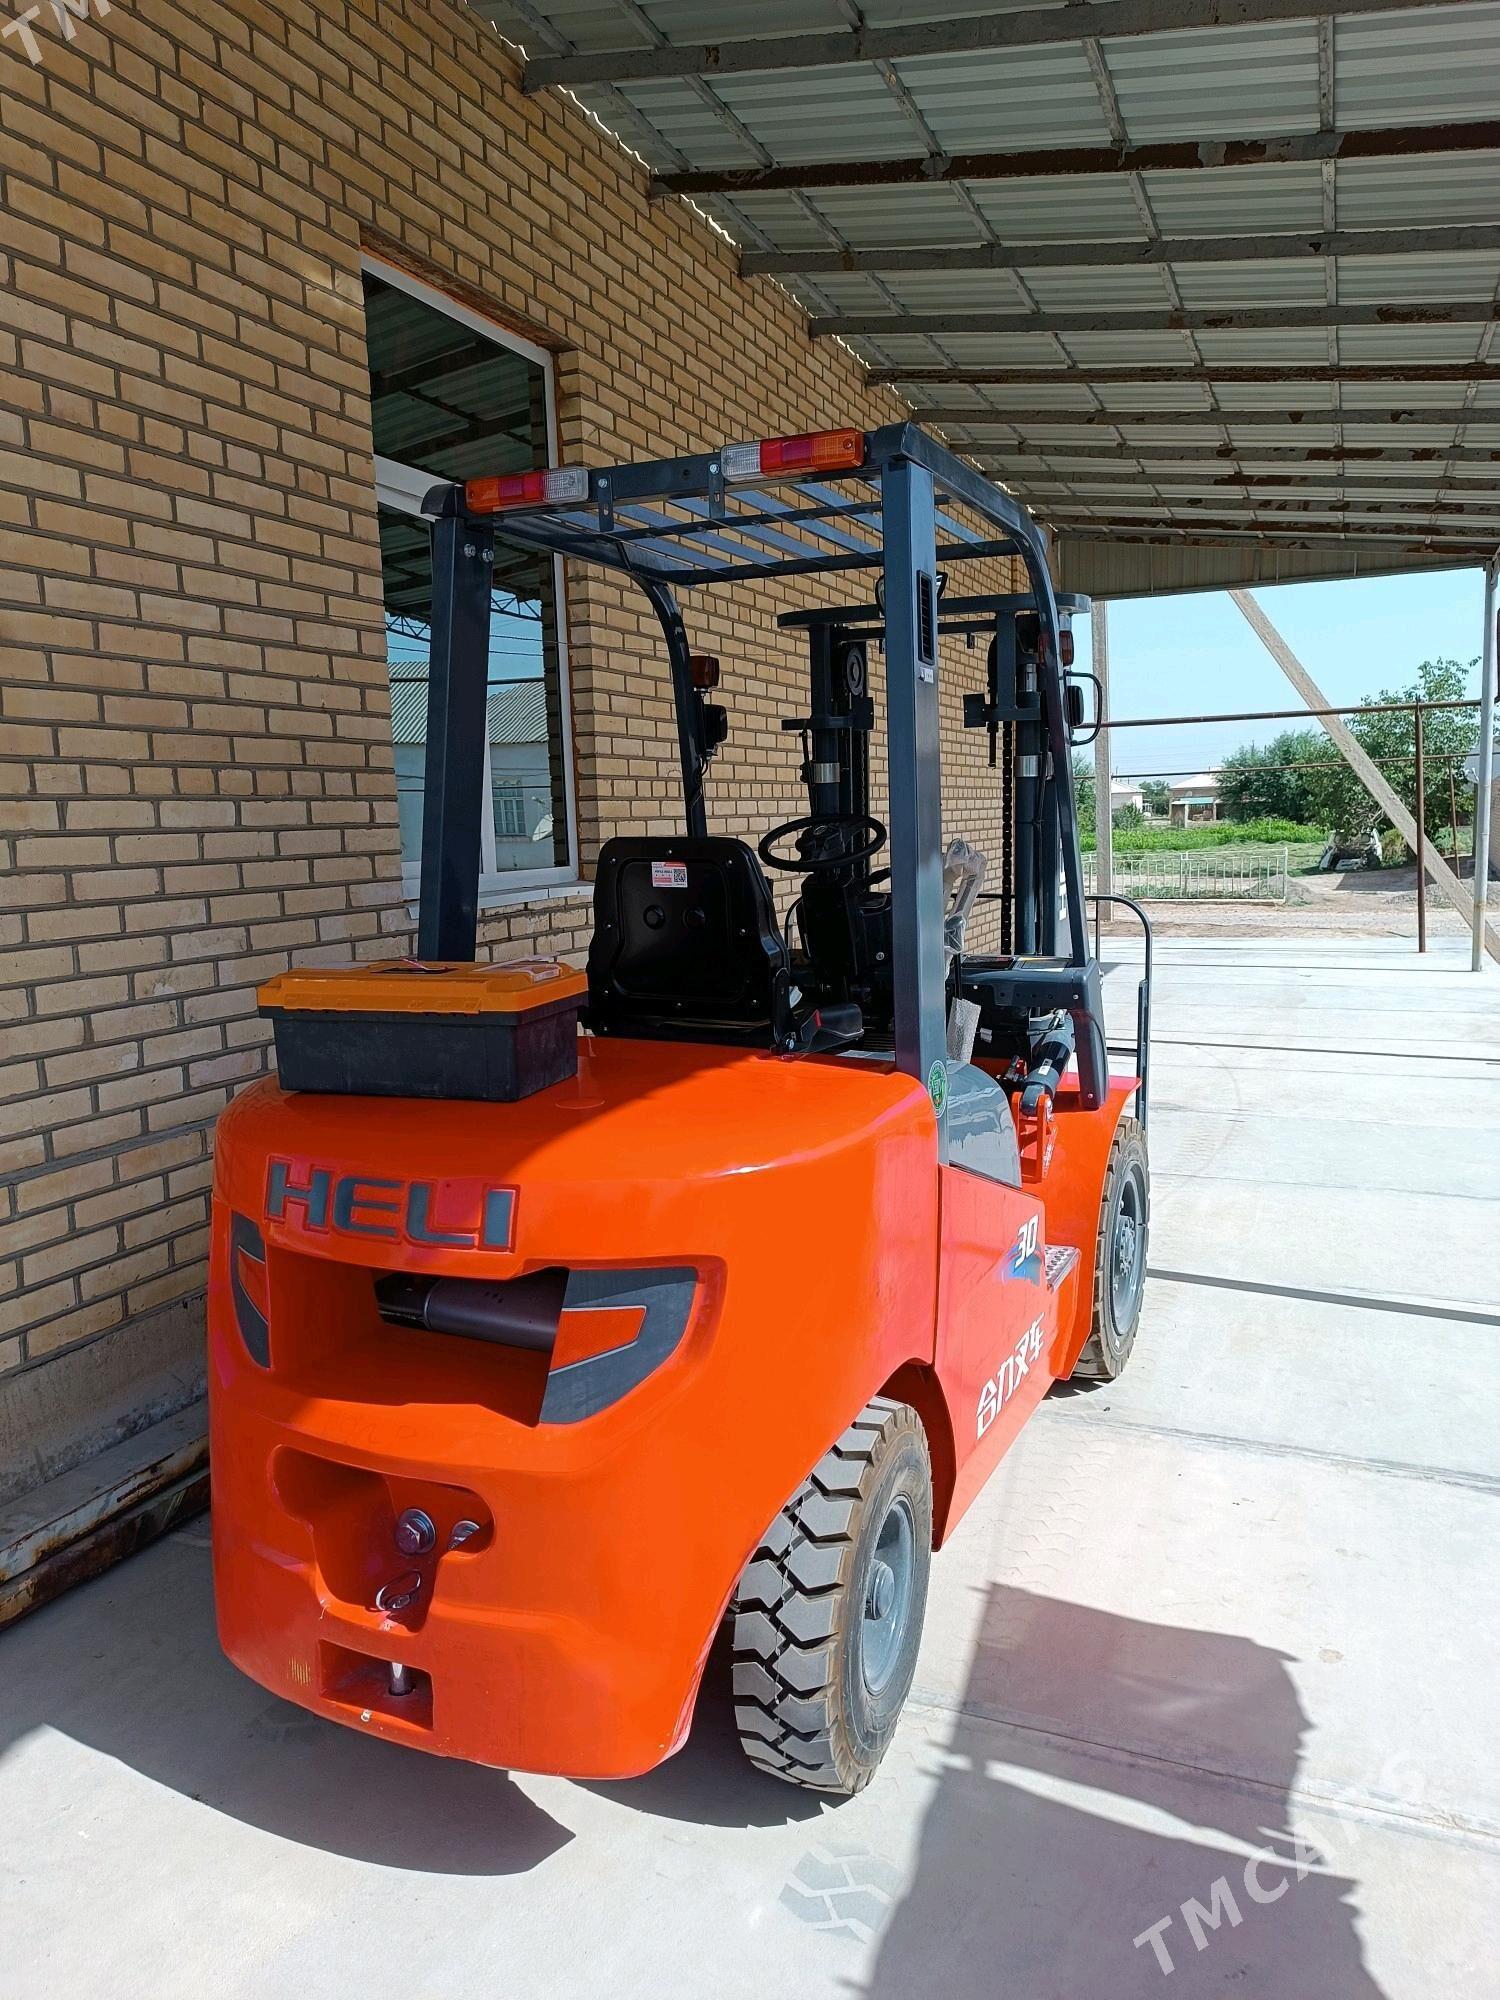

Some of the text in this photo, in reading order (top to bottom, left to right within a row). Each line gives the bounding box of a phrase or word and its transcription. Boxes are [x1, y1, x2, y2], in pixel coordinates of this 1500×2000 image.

[265, 1156, 518, 1253] HELI
[1014, 1214, 1040, 1269] 30
[976, 1311, 1045, 1441] 合力叉车
